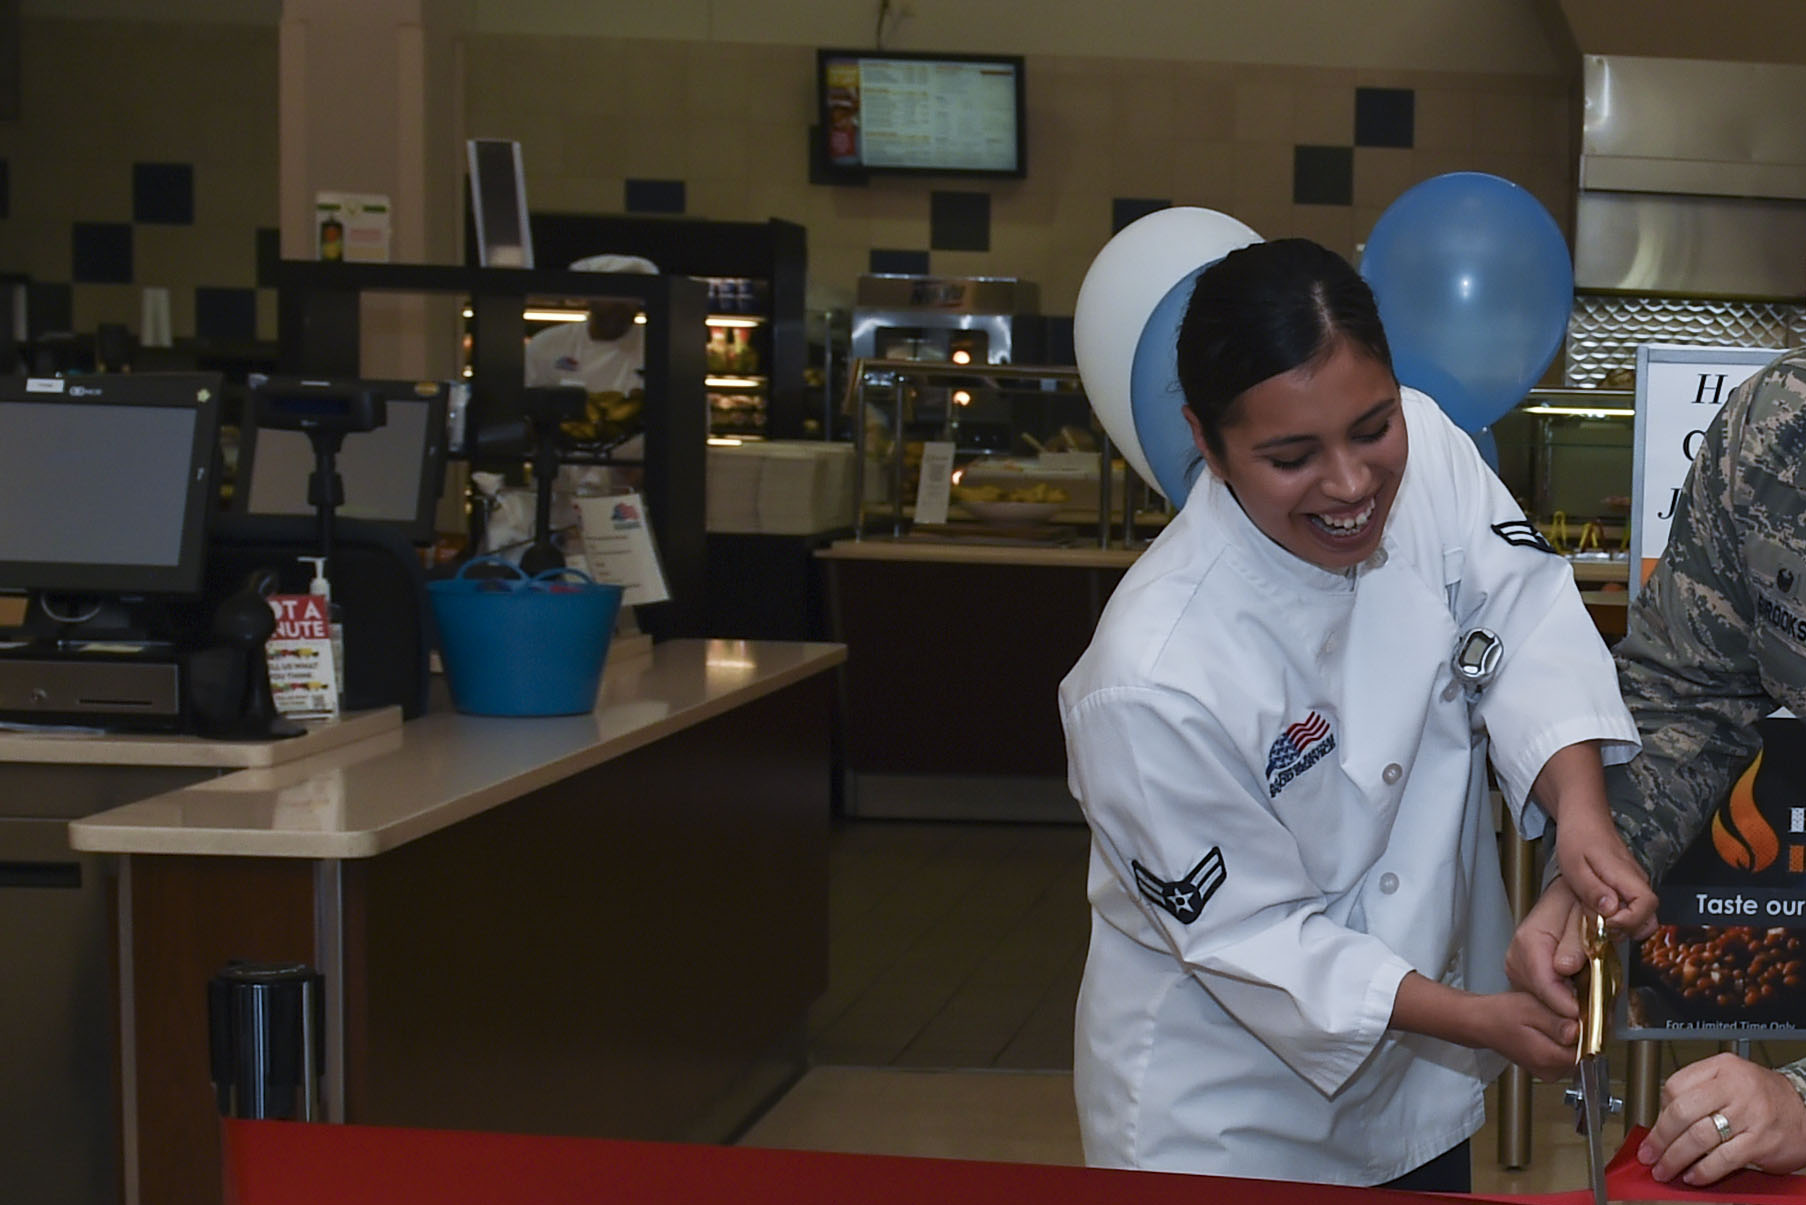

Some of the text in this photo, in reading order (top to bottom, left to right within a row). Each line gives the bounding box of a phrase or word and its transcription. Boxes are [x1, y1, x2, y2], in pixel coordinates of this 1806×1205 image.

[1692, 373, 1738, 404] H
[303, 600, 322, 620] A
[271, 621, 326, 638] NUTE
[1696, 893, 1758, 915] Taste
[1766, 898, 1806, 917] our
[1665, 1020, 1685, 1030] For
[1695, 1019, 1737, 1031] Limited
[1739, 1020, 1767, 1031] Time
